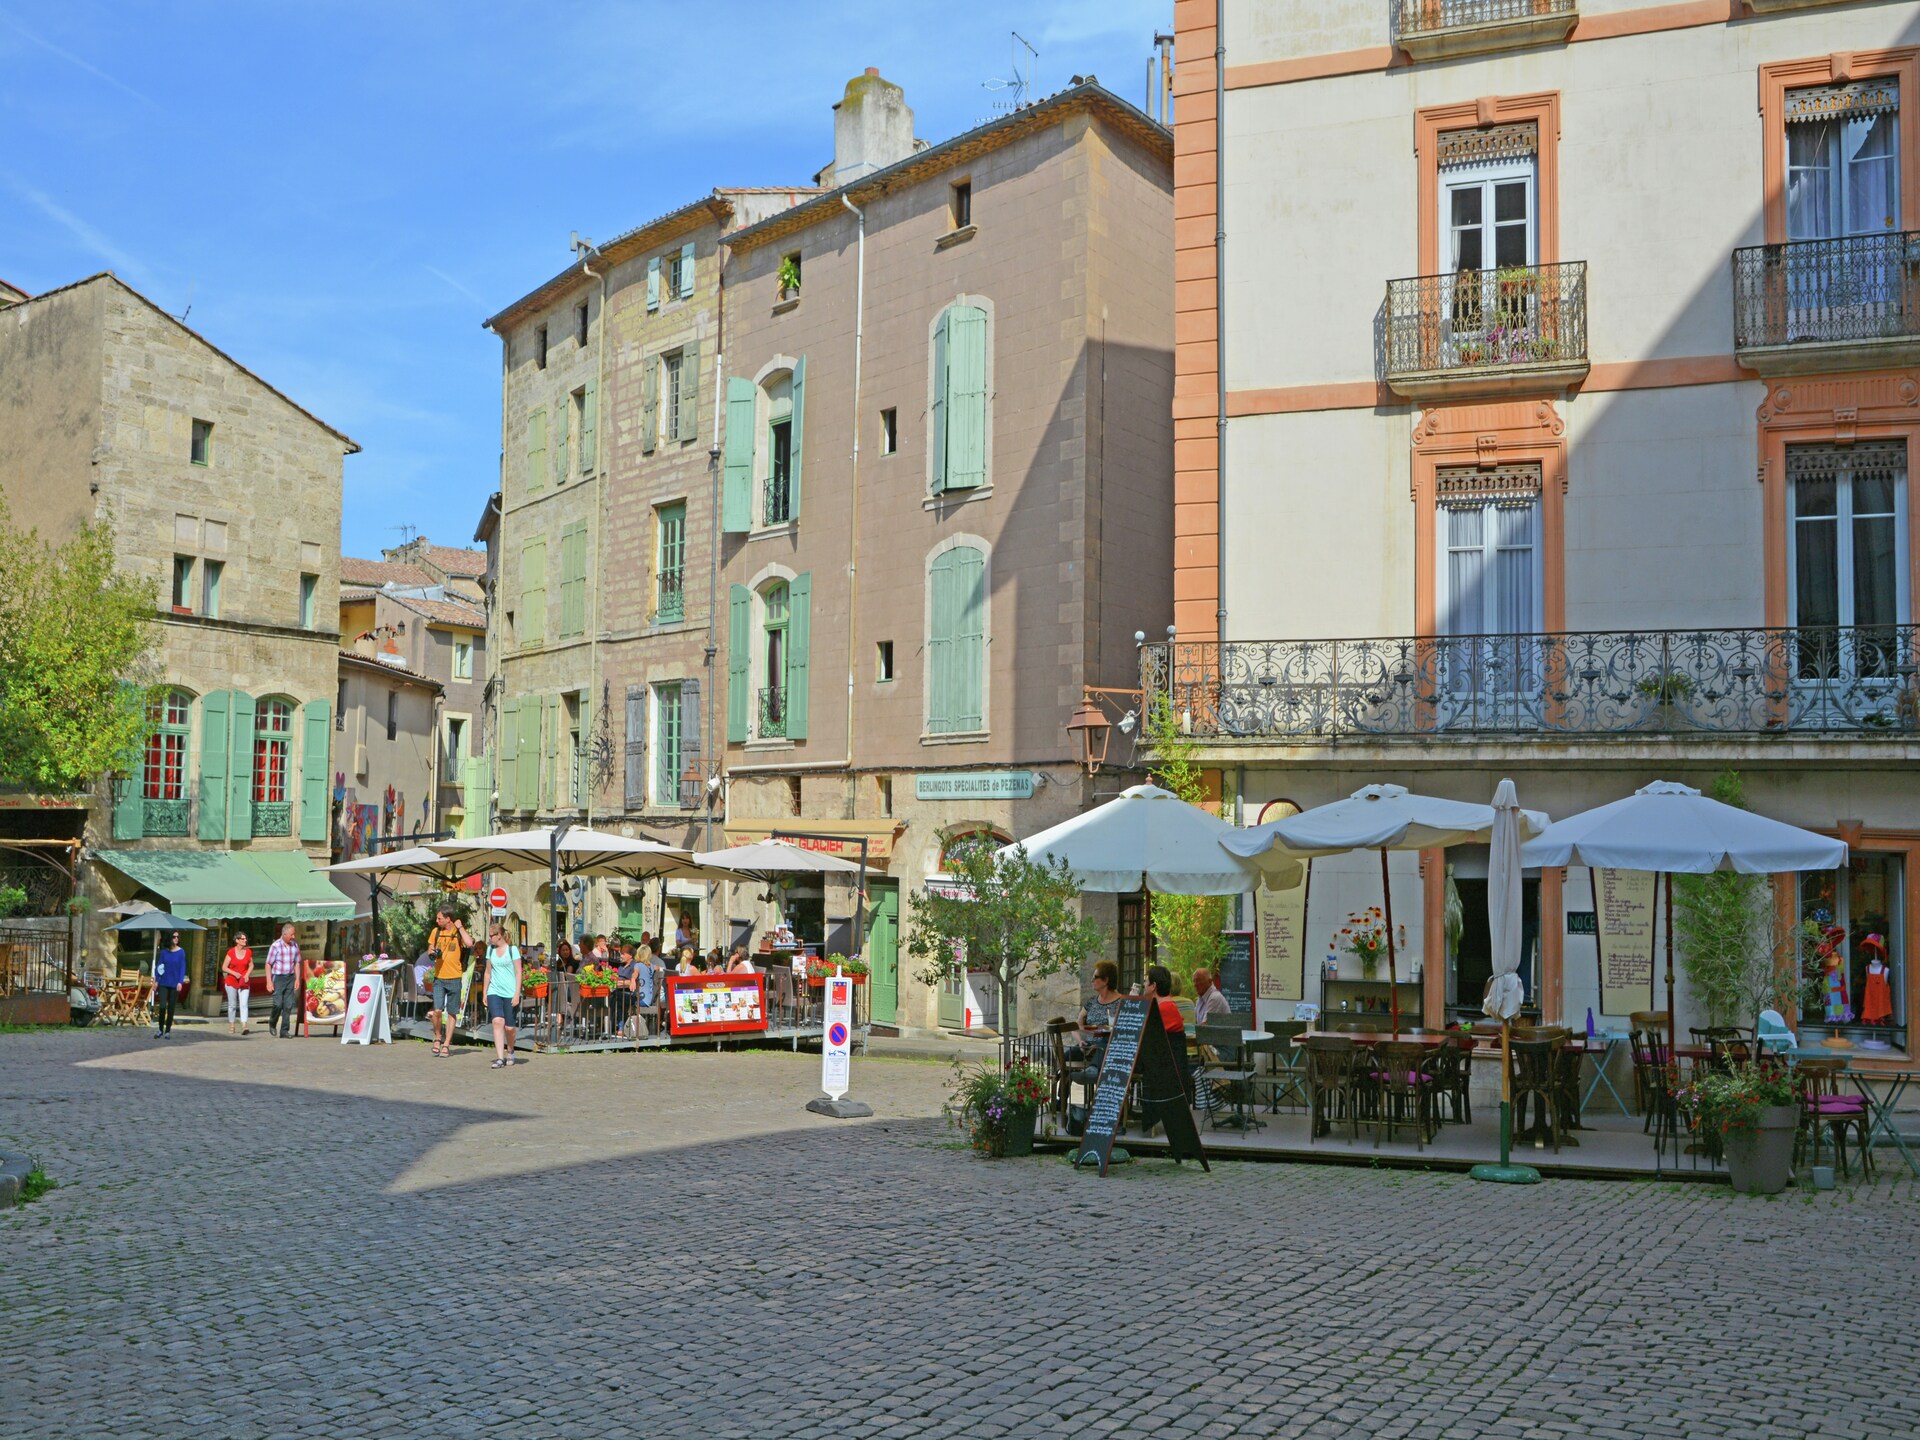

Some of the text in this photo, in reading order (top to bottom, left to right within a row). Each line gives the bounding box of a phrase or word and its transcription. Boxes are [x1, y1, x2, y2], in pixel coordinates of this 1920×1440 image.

[919, 778, 1029, 793] BERLINGOTS SPECIALITES de PEZENAS
[798, 836, 844, 853] GLACIER
